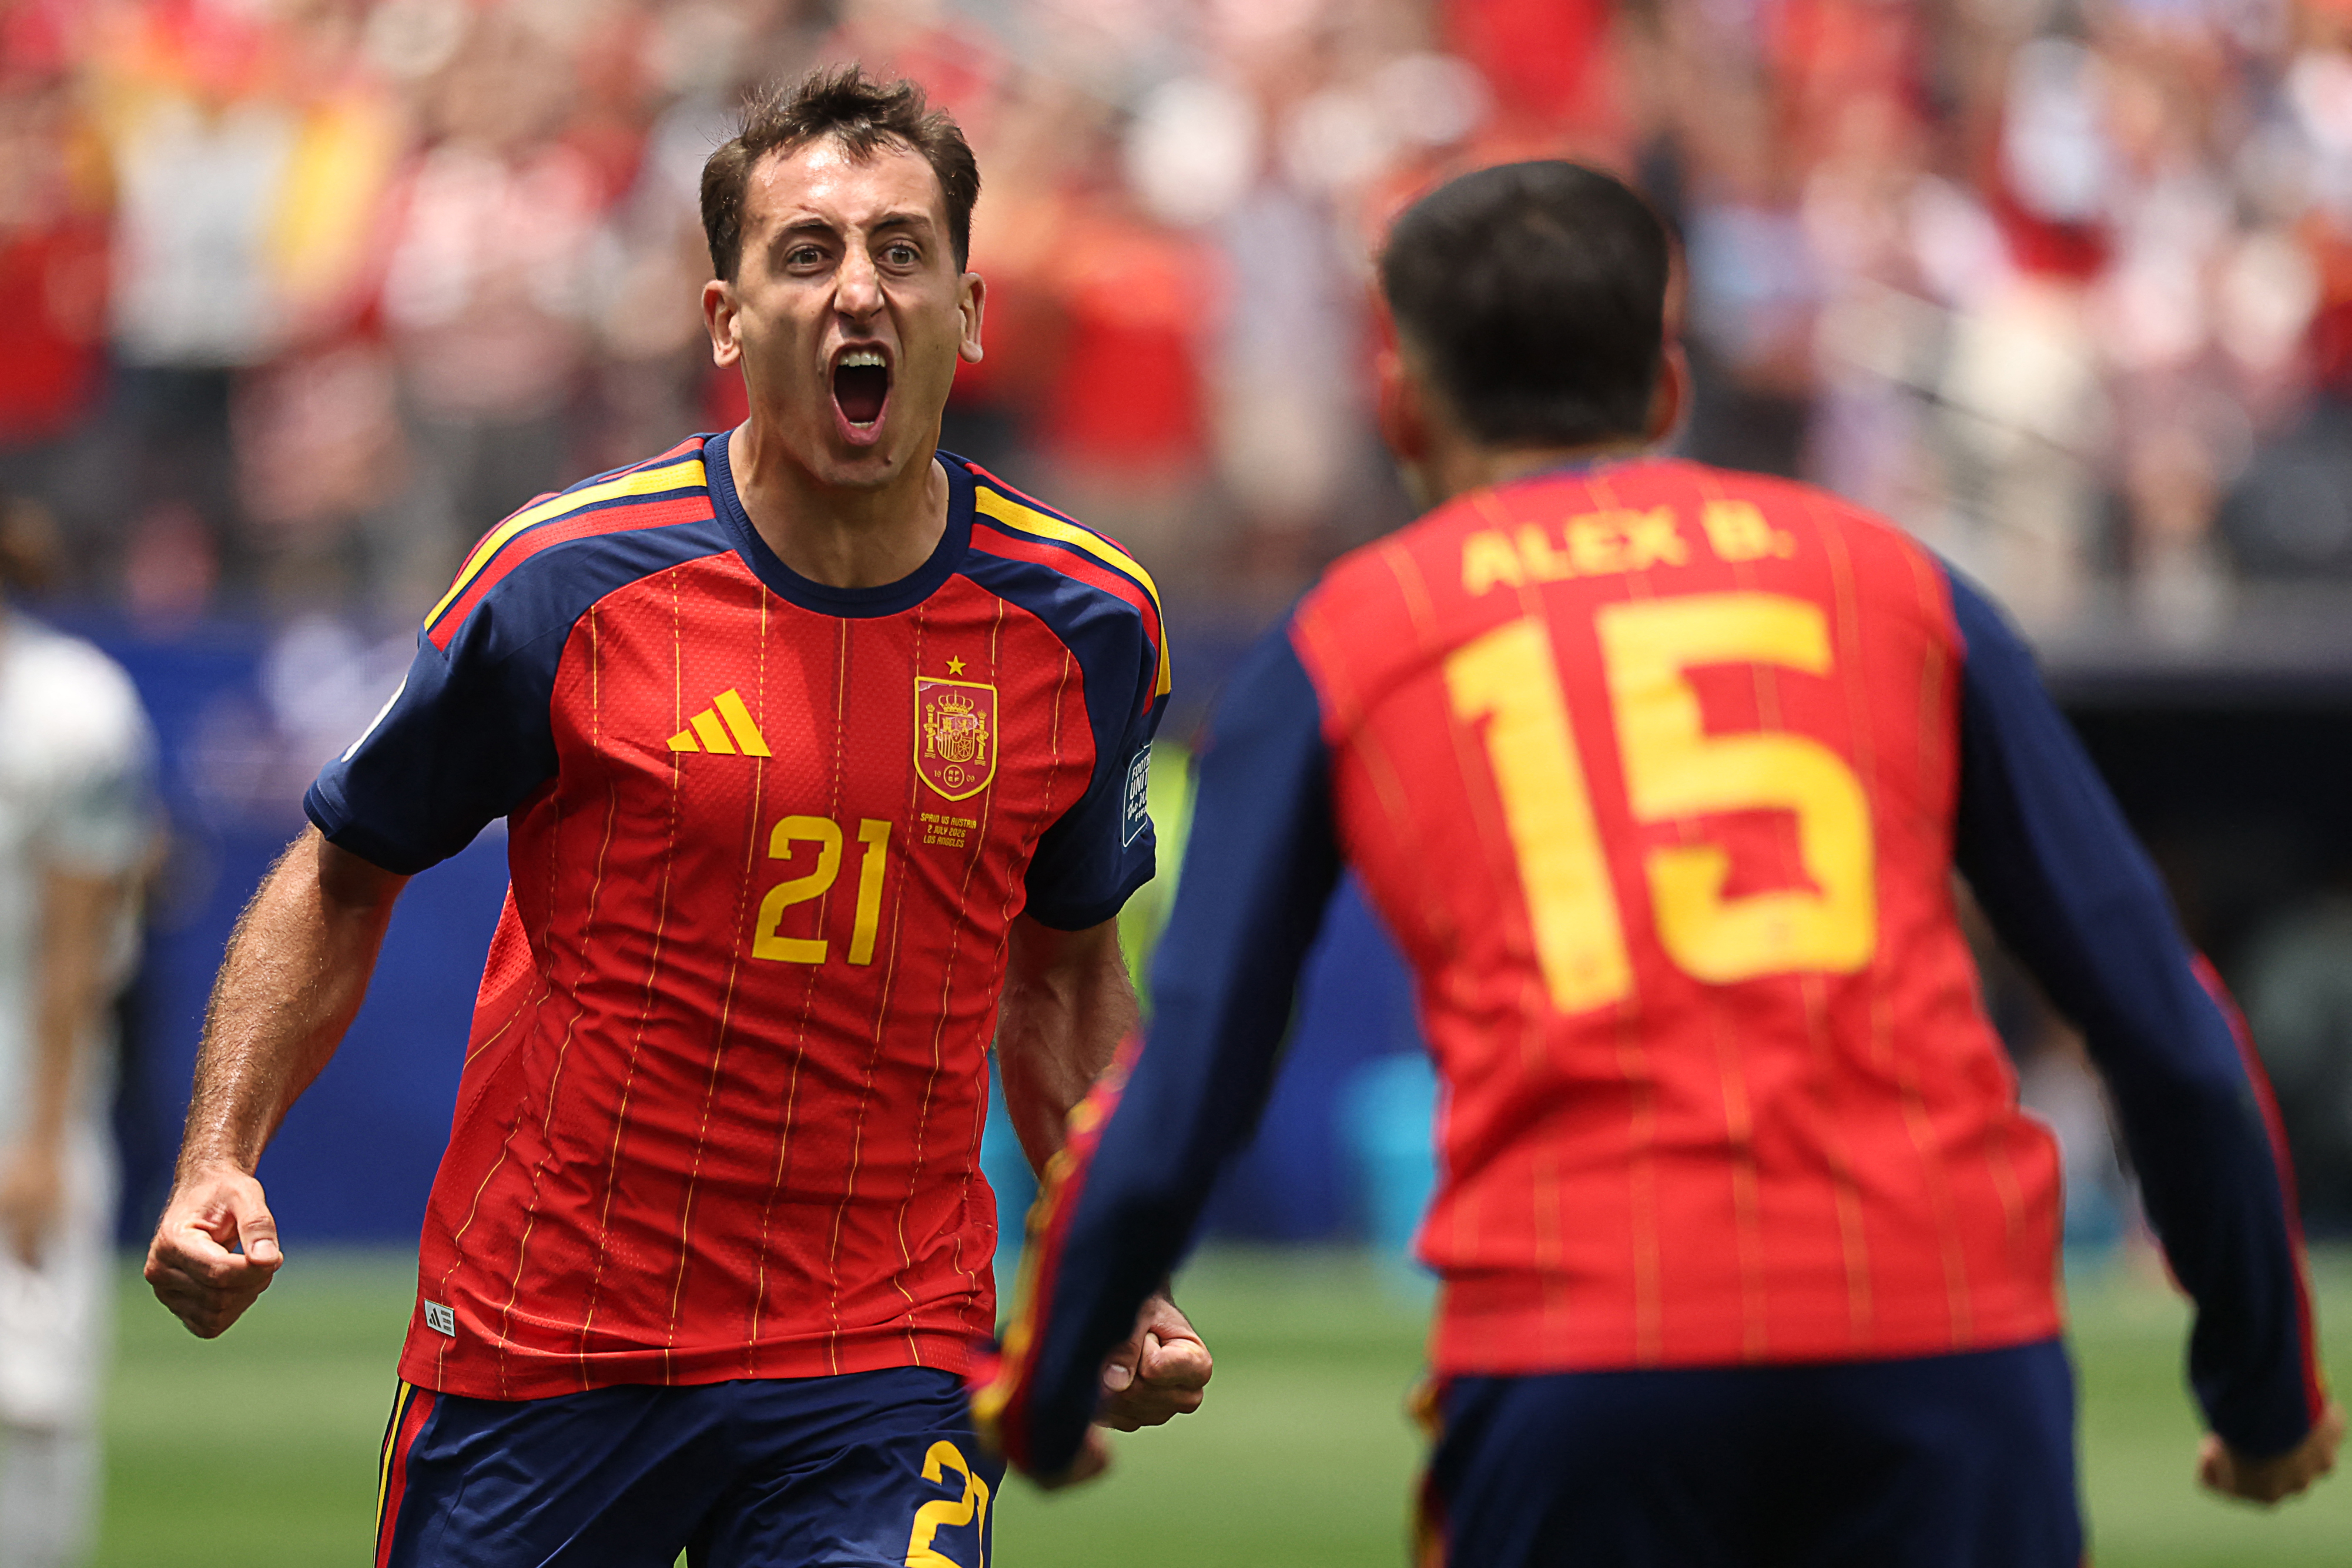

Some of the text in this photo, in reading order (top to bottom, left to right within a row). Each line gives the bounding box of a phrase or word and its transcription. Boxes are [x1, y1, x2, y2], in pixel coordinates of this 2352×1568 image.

[1461, 499, 1797, 596] ALEX B.
[920, 812, 940, 823] SPAIN
[950, 817, 977, 829] AUSTRIA
[923, 835, 965, 848] LOS ANGELES
[927, 824, 966, 837] 2 JULY 2026
[1443, 591, 1877, 1015] 15
[752, 815, 892, 966] 21
[904, 1440, 990, 1568] 21
